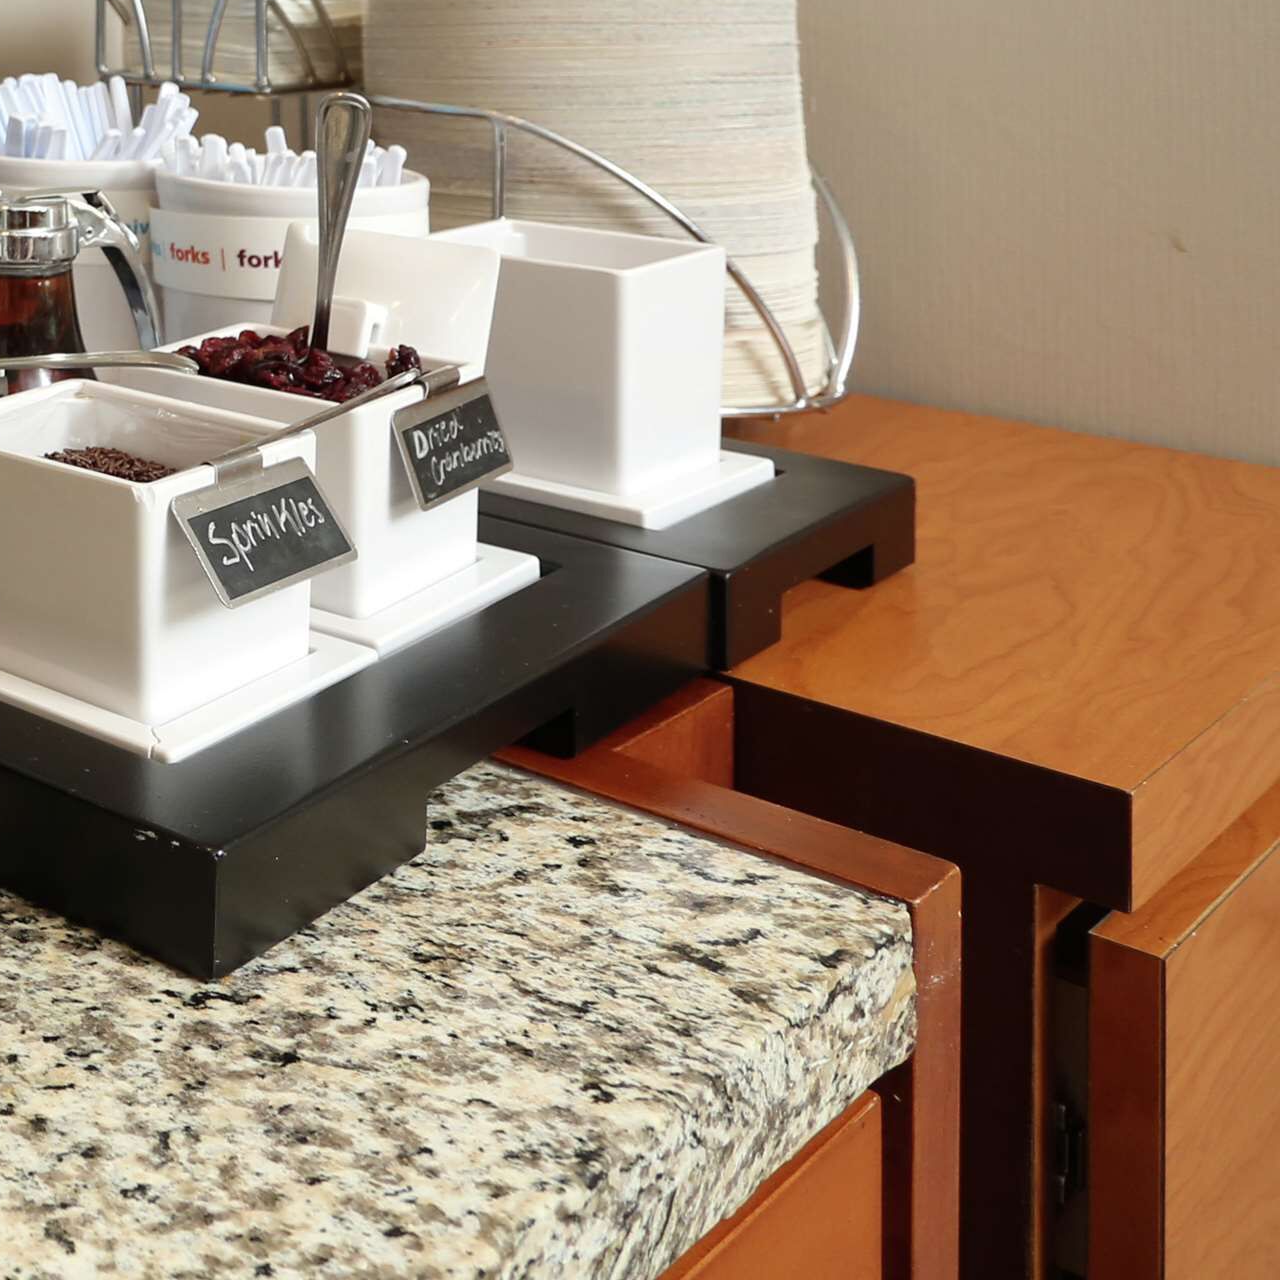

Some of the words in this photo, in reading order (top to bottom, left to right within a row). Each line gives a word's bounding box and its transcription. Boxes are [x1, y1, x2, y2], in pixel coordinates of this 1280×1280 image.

[169, 242, 210, 265] forks
[236, 248, 284, 269] fork
[412, 411, 464, 459] Dried
